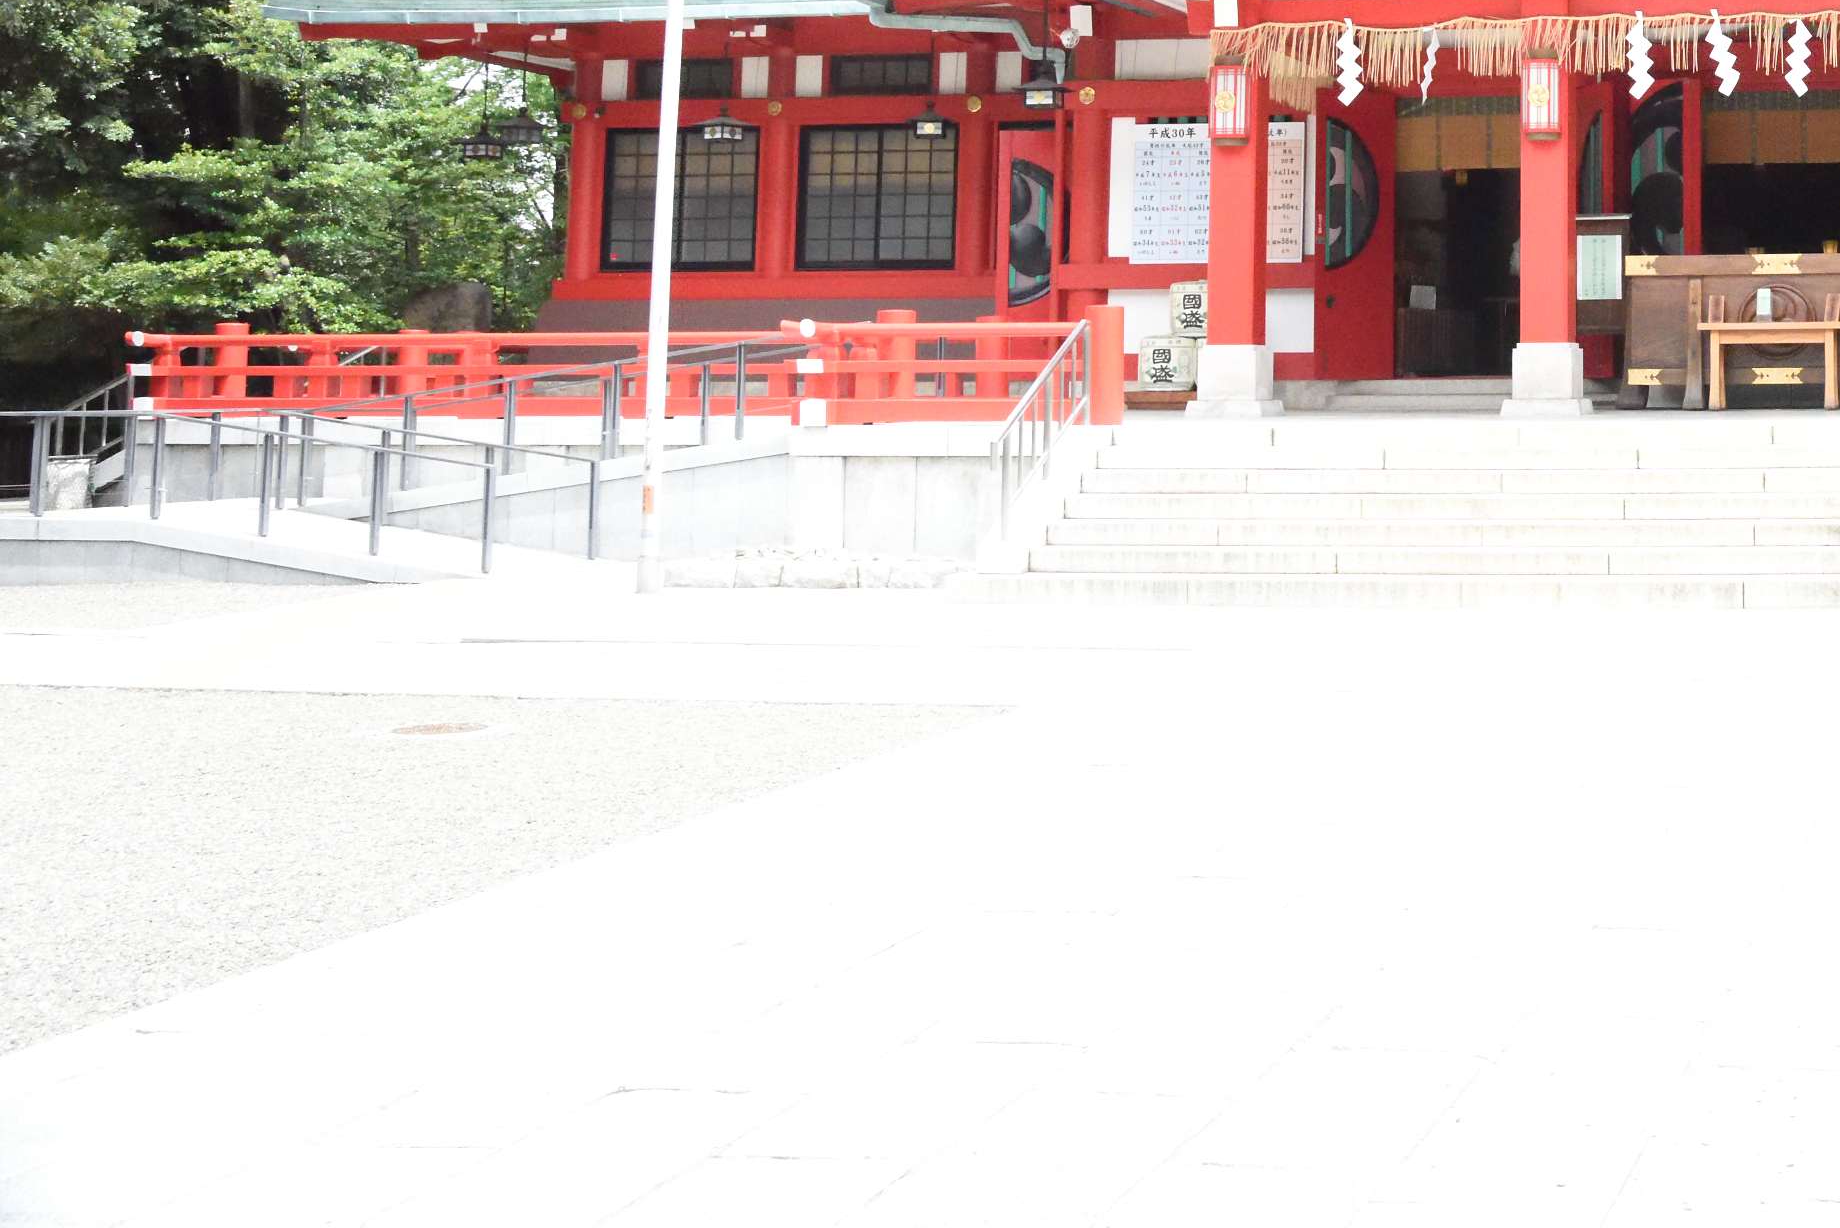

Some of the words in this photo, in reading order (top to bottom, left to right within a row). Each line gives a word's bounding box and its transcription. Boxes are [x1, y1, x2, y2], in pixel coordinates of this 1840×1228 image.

[1148, 127, 1197, 139] 平成30年
[1181, 294, 1205, 329] 國盛
[1151, 348, 1175, 384] 國盛
